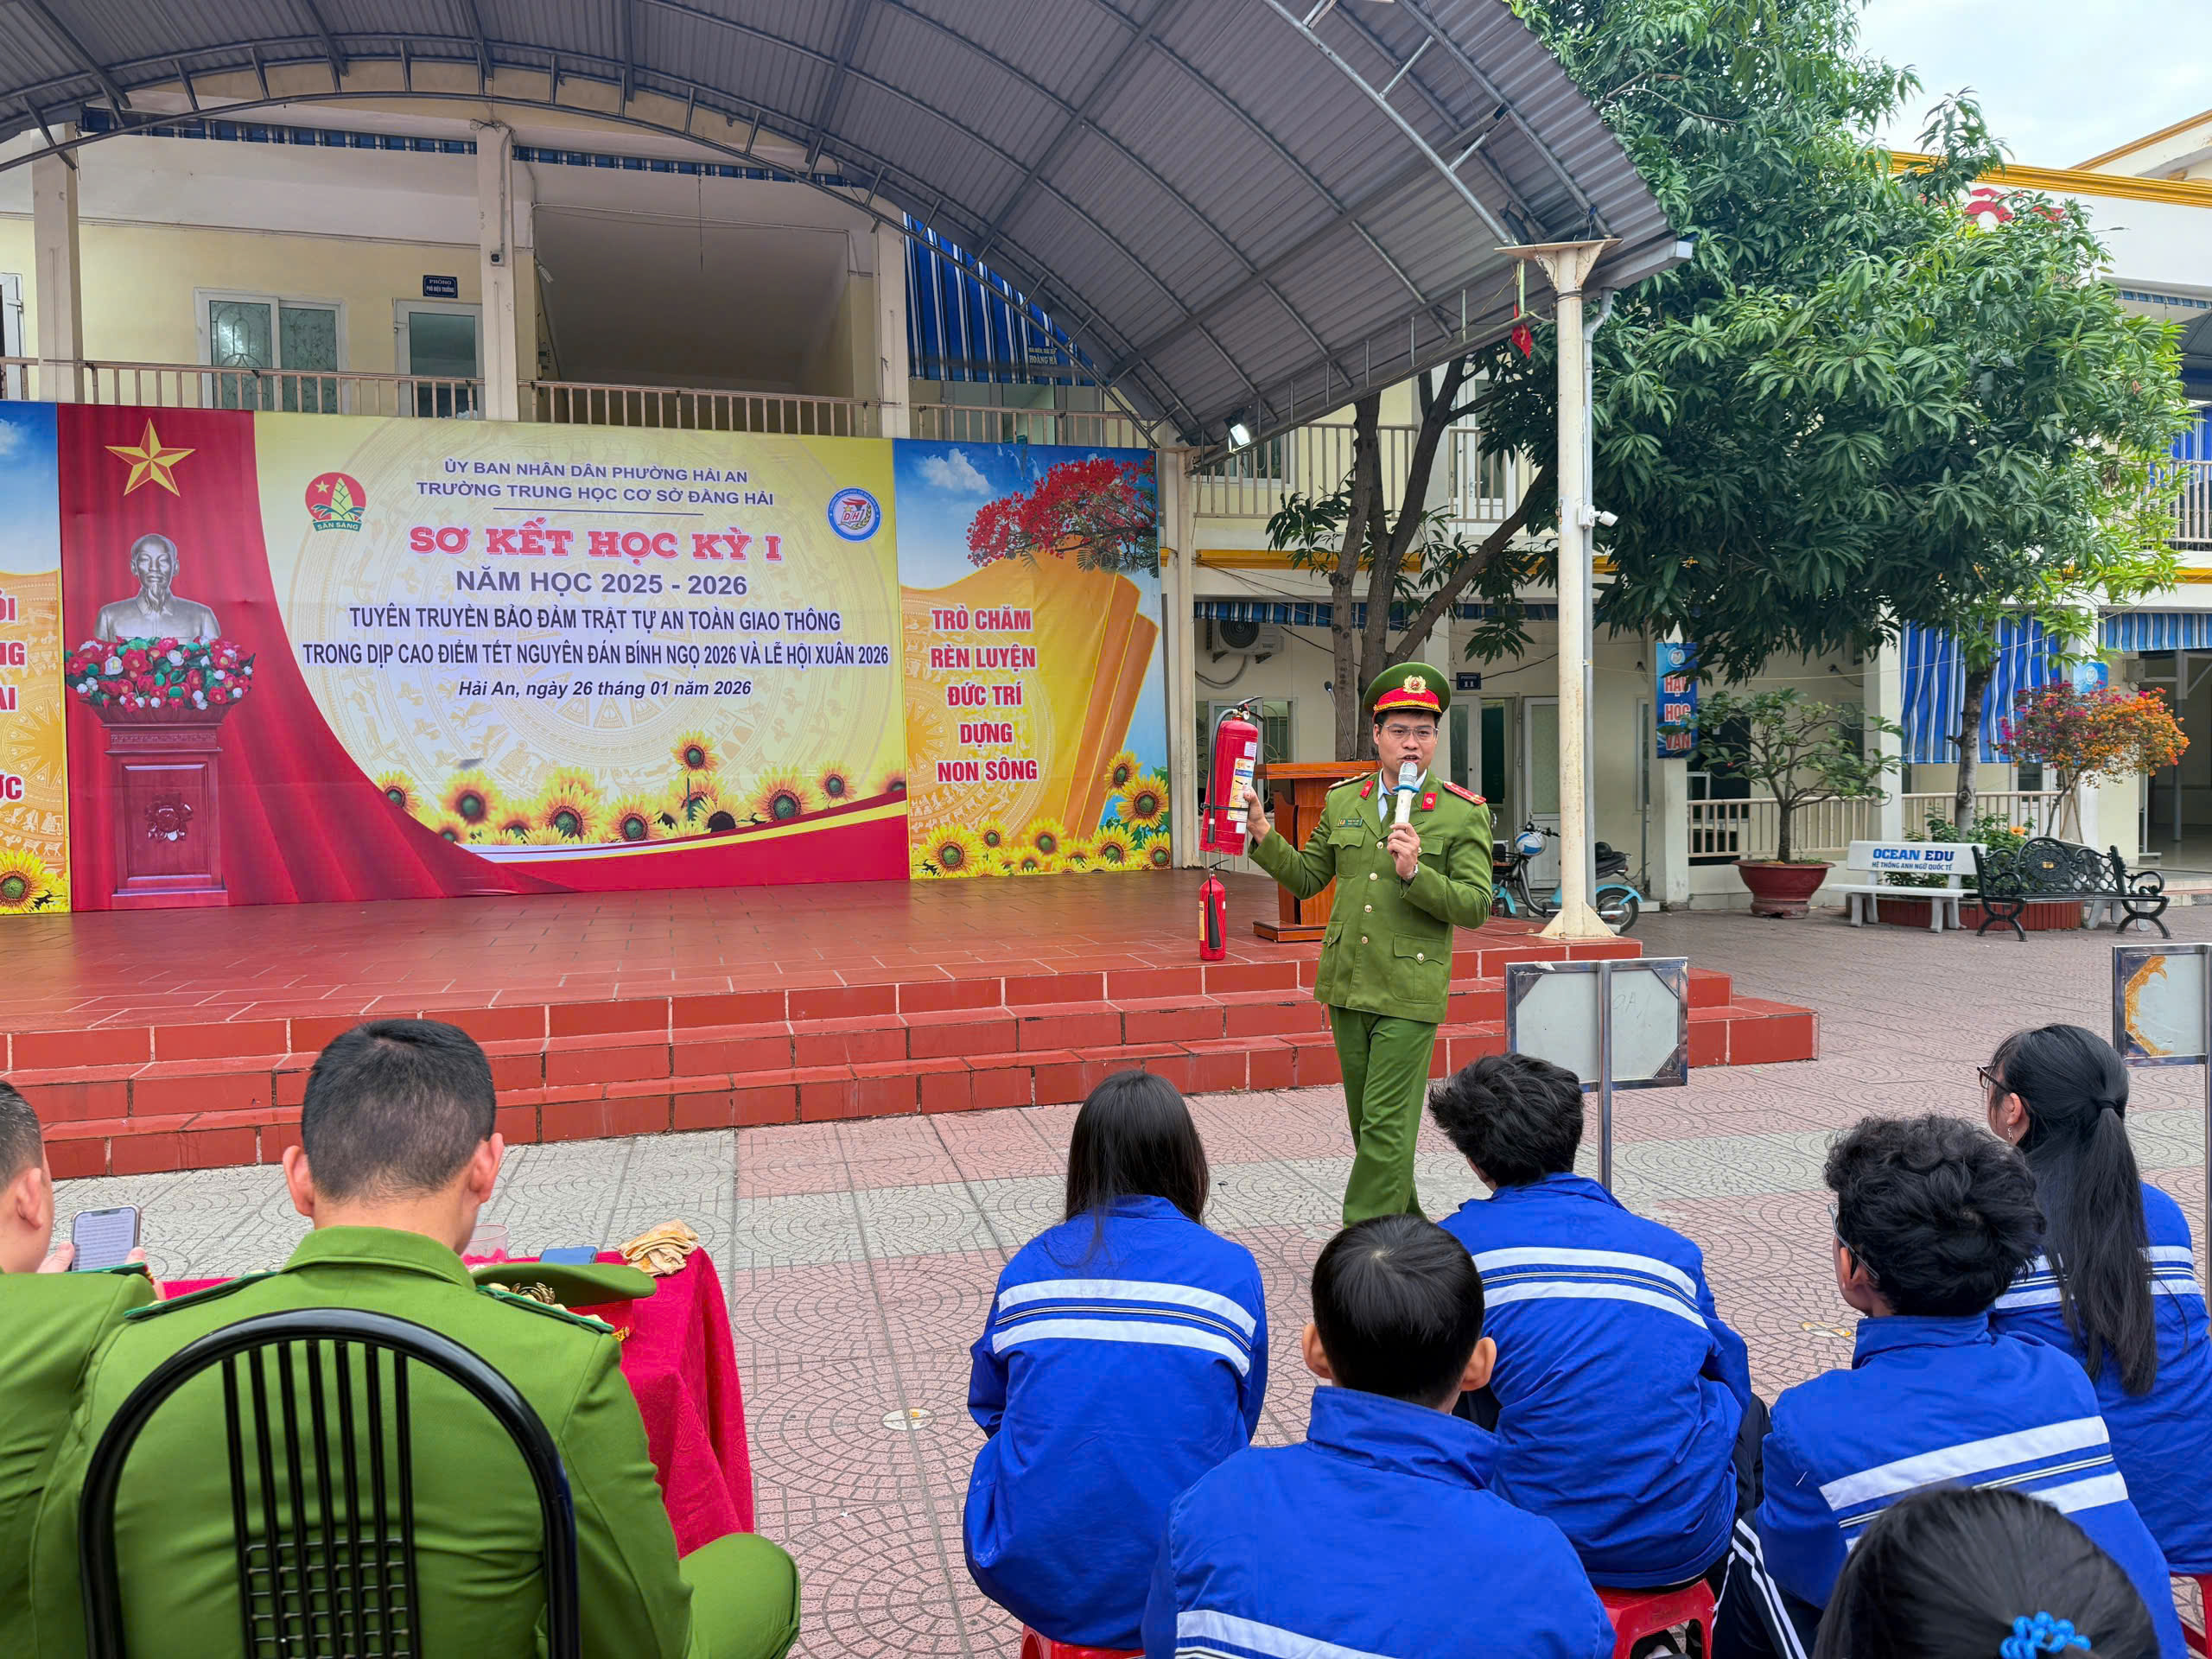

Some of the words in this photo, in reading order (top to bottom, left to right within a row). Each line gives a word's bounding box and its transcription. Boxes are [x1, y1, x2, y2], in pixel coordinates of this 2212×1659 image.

[445, 459, 468, 473] ỦY
[474, 462, 510, 474] BAN
[517, 462, 565, 476] NHÂN
[571, 463, 606, 477] DÂN
[613, 466, 687, 480] PHƯỜNG
[693, 468, 720, 482] HẢI
[725, 472, 747, 482] AN
[416, 480, 501, 496] TRƯỜNG
[507, 485, 572, 499] TRUNG
[579, 487, 617, 502] HỌC
[624, 489, 652, 500] CƠ
[657, 487, 683, 502] SỞ
[745, 490, 773, 505] HẢI
[410, 526, 470, 554] SƠ
[486, 518, 573, 556] KẾT
[588, 531, 677, 566] HỌC
[692, 527, 752, 560] KỲ
[766, 536, 781, 561] I
[457, 566, 519, 590] NĂM
[531, 572, 592, 597] HỌC
[601, 574, 663, 594] 2025
[688, 575, 747, 594] 2026
[350, 602, 410, 627] TUYÊN
[416, 604, 487, 627] TRUYỀN
[494, 604, 532, 627] BẢO
[537, 605, 576, 628] ĐẢM
[582, 607, 626, 633] TRẬT
[632, 610, 657, 633] TỰ
[661, 611, 683, 629] AN
[689, 607, 734, 629] TOÀN
[740, 612, 780, 630] GIAO
[785, 608, 840, 631] THÔNG
[931, 605, 969, 630] TRÒ
[975, 606, 1031, 630] CHĂM
[302, 644, 362, 664] TRONG
[367, 644, 393, 669] DỊP
[398, 644, 433, 664] CAO
[438, 639, 478, 664] ĐIỂM
[482, 639, 512, 664] TẾT
[518, 639, 582, 664] NGUYÊN
[588, 639, 620, 664] ĐÁN
[626, 639, 661, 664] BÍNH
[667, 645, 700, 669] NGỌ
[704, 645, 736, 664] 2026
[741, 641, 760, 664] VÀ
[766, 641, 783, 664] LỄ
[787, 643, 811, 669] HỘI
[816, 641, 854, 664] XUÂN
[858, 646, 888, 664] 2026
[931, 644, 969, 668] RÈN
[976, 644, 1036, 672] LUYỆN
[459, 680, 487, 696] Hải
[491, 681, 519, 698] An,
[526, 681, 568, 699] ngày
[573, 681, 593, 696] 26
[598, 681, 645, 699] tháng
[651, 681, 668, 695] 01
[675, 681, 709, 695] năm
[714, 681, 751, 695] 2026
[947, 682, 987, 706] ĐỨC
[992, 682, 1021, 705] TRÍ
[960, 722, 1013, 747] DỰNG
[938, 761, 979, 782] NON
[985, 757, 1037, 781] SÔNG
[1873, 849, 1921, 860] OCEAN
[1924, 850, 1955, 861] EDU
